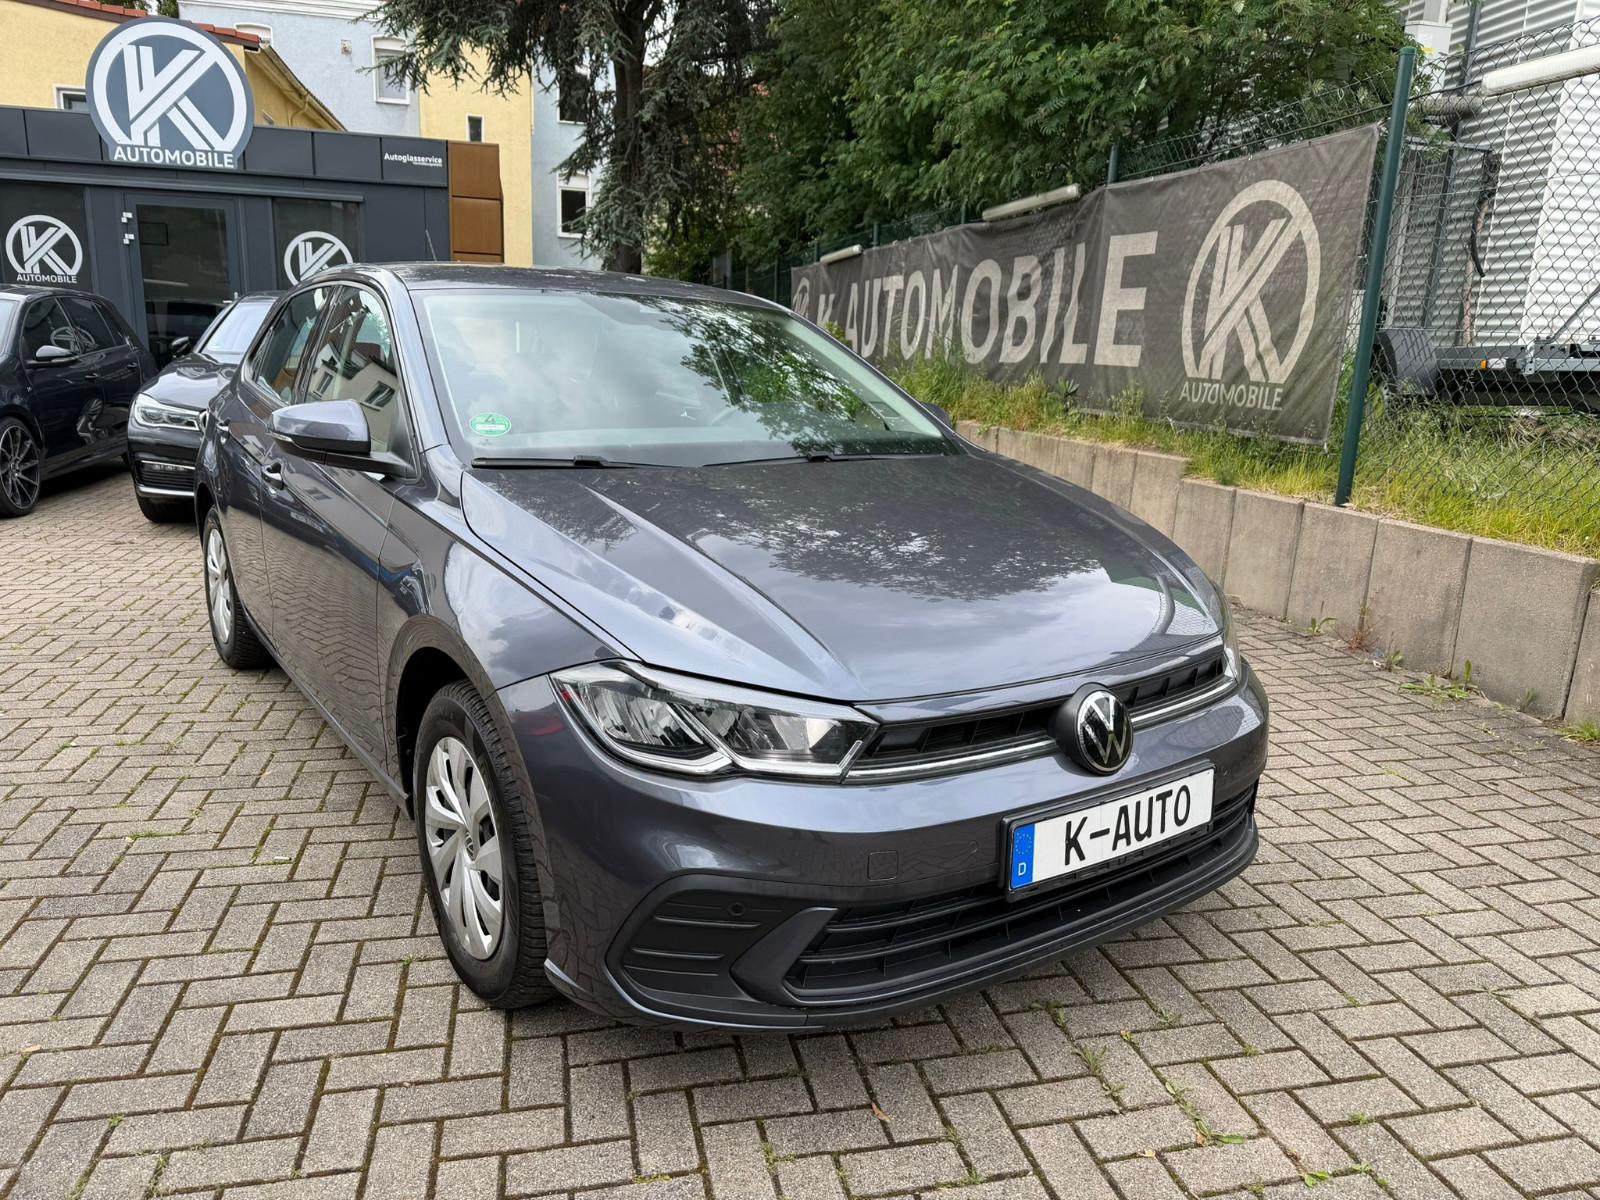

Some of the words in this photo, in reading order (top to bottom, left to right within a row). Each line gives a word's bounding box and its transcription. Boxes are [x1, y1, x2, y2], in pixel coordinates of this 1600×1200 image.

[113, 146, 235, 168] AUTOMOBILE
[384, 152, 443, 164] Autoglasservice
[16, 273, 78, 284] AUTOMOBILE
[845, 231, 1158, 368] AUTOMOBILE
[1179, 381, 1283, 411] AUTOMOBILE
[1064, 784, 1192, 867] K-AUTO
[1017, 862, 1027, 876] D
